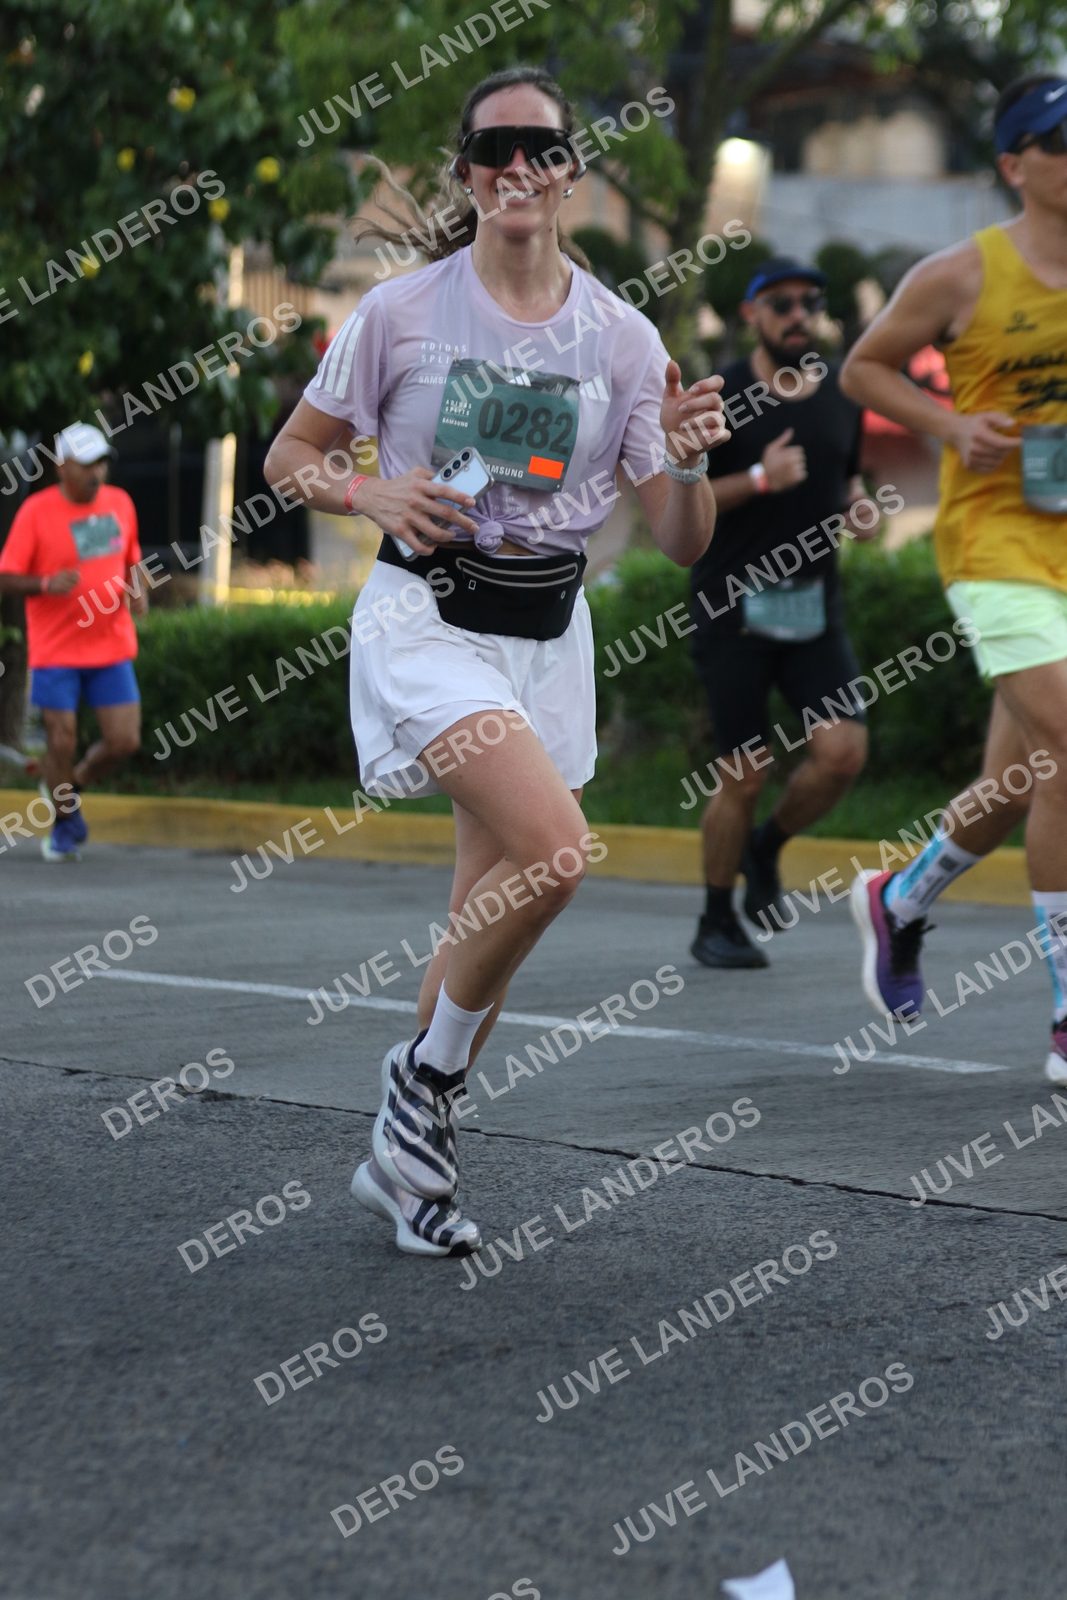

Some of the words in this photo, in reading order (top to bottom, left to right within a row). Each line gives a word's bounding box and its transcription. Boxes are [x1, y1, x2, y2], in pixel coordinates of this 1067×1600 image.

[421, 342, 467, 353] ADIDAS
[421, 354, 450, 364] SPLI
[418, 375, 447, 385] SAMS
[477, 398, 573, 455] 0282
[486, 464, 524, 478] AMSUNG
